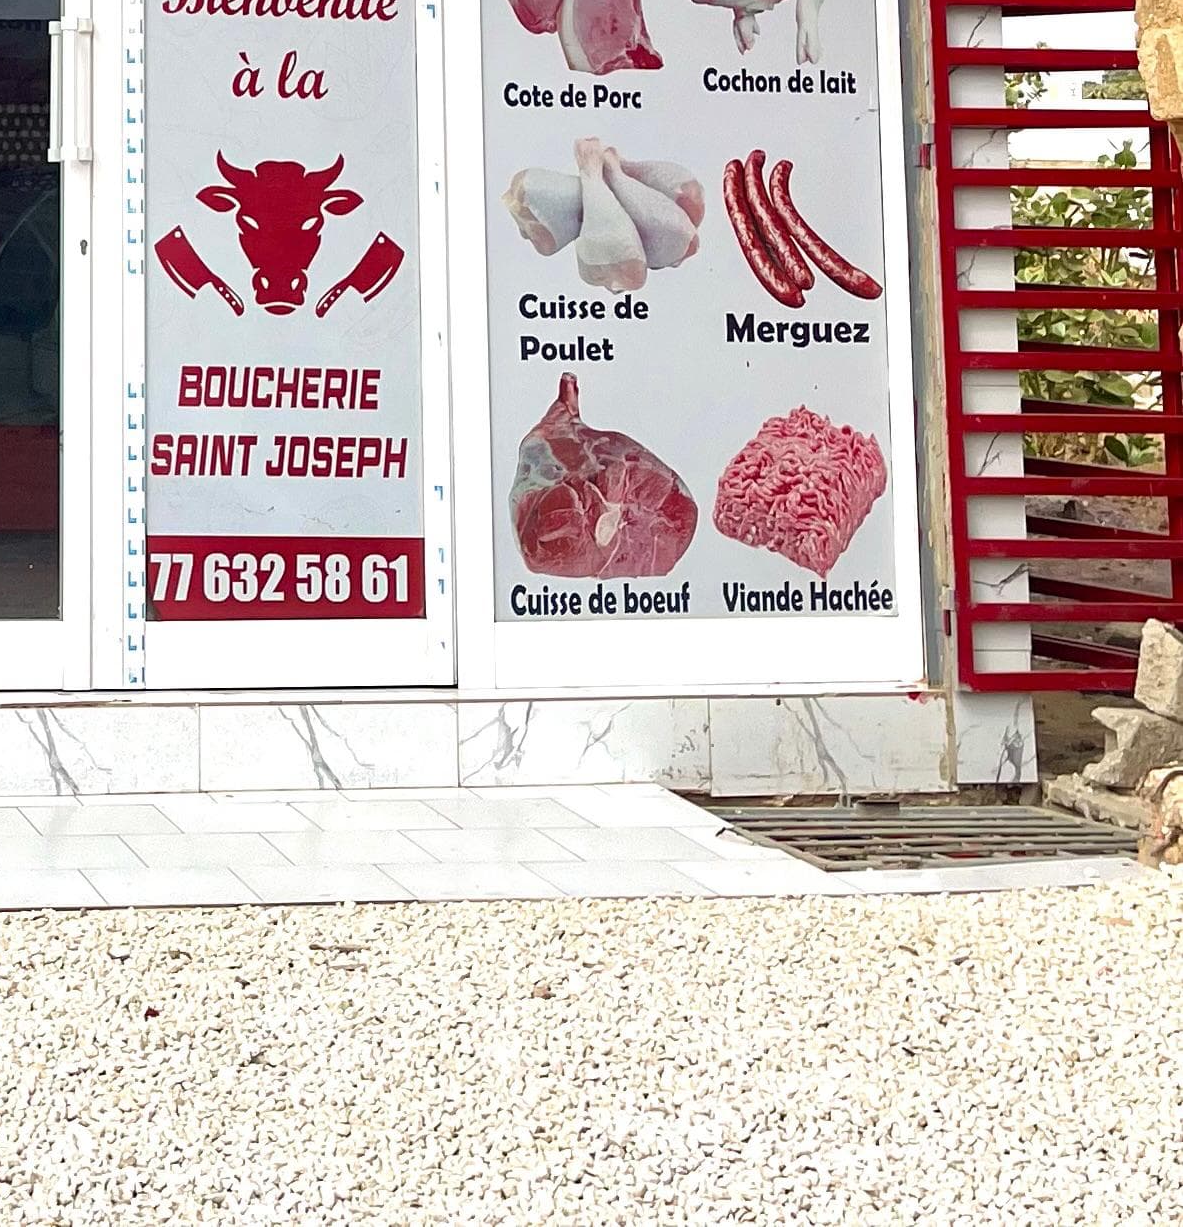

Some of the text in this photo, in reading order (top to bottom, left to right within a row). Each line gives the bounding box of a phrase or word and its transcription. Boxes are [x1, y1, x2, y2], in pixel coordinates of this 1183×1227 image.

[232, 50, 329, 100] à la
[703, 68, 857, 95] Cochon de lait
[503, 82, 642, 109] Cote de Porc
[518, 293, 649, 320] Cuisse de
[726, 312, 870, 348] Merguez
[520, 335, 614, 362] Poulet
[178, 365, 381, 409] BOUCHERIE
[151, 434, 408, 478] SAINT JOSEPH
[150, 553, 408, 603] 77 632 58 61
[510, 582, 691, 616] Cuisse de boeuf
[722, 579, 893, 612] Viande Hachée
